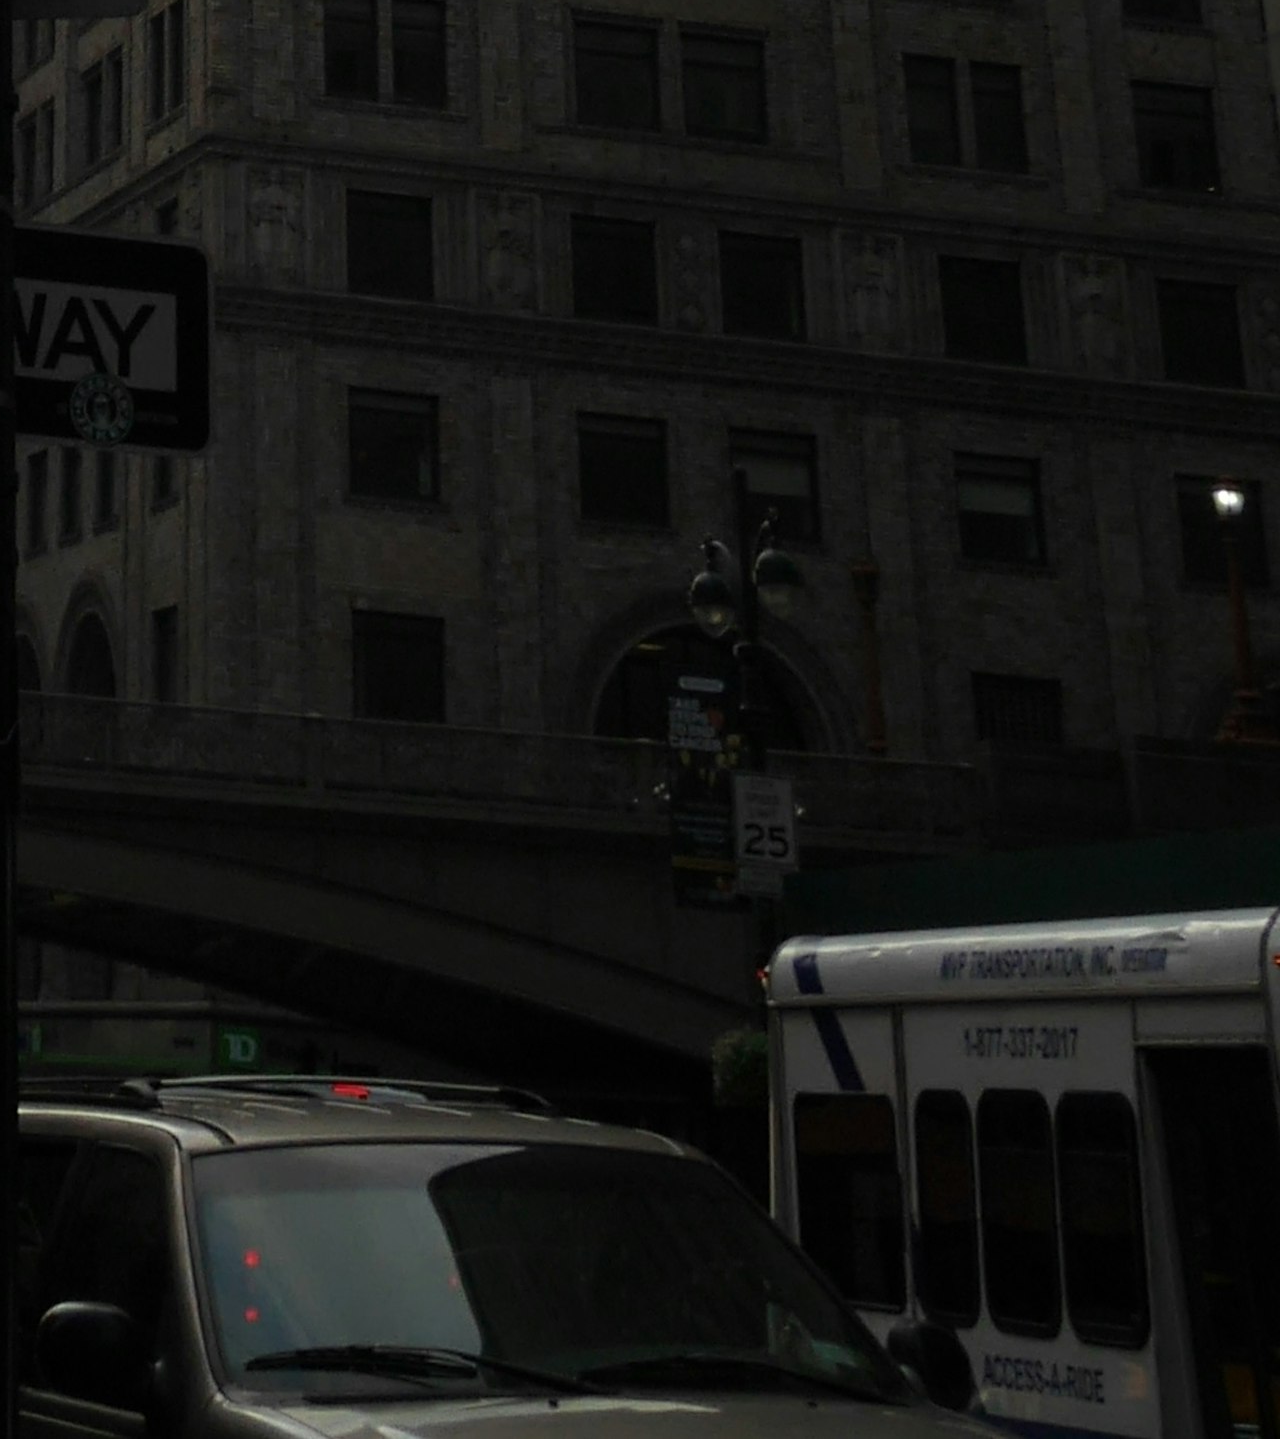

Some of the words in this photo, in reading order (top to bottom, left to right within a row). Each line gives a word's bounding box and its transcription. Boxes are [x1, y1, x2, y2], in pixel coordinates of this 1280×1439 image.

[744, 823, 789, 857] 25
[224, 1032, 259, 1063] TD
[963, 1027, 1078, 1059] 1-877-337-2017
[982, 1355, 1105, 1404] ACCESS-A-RIDE
